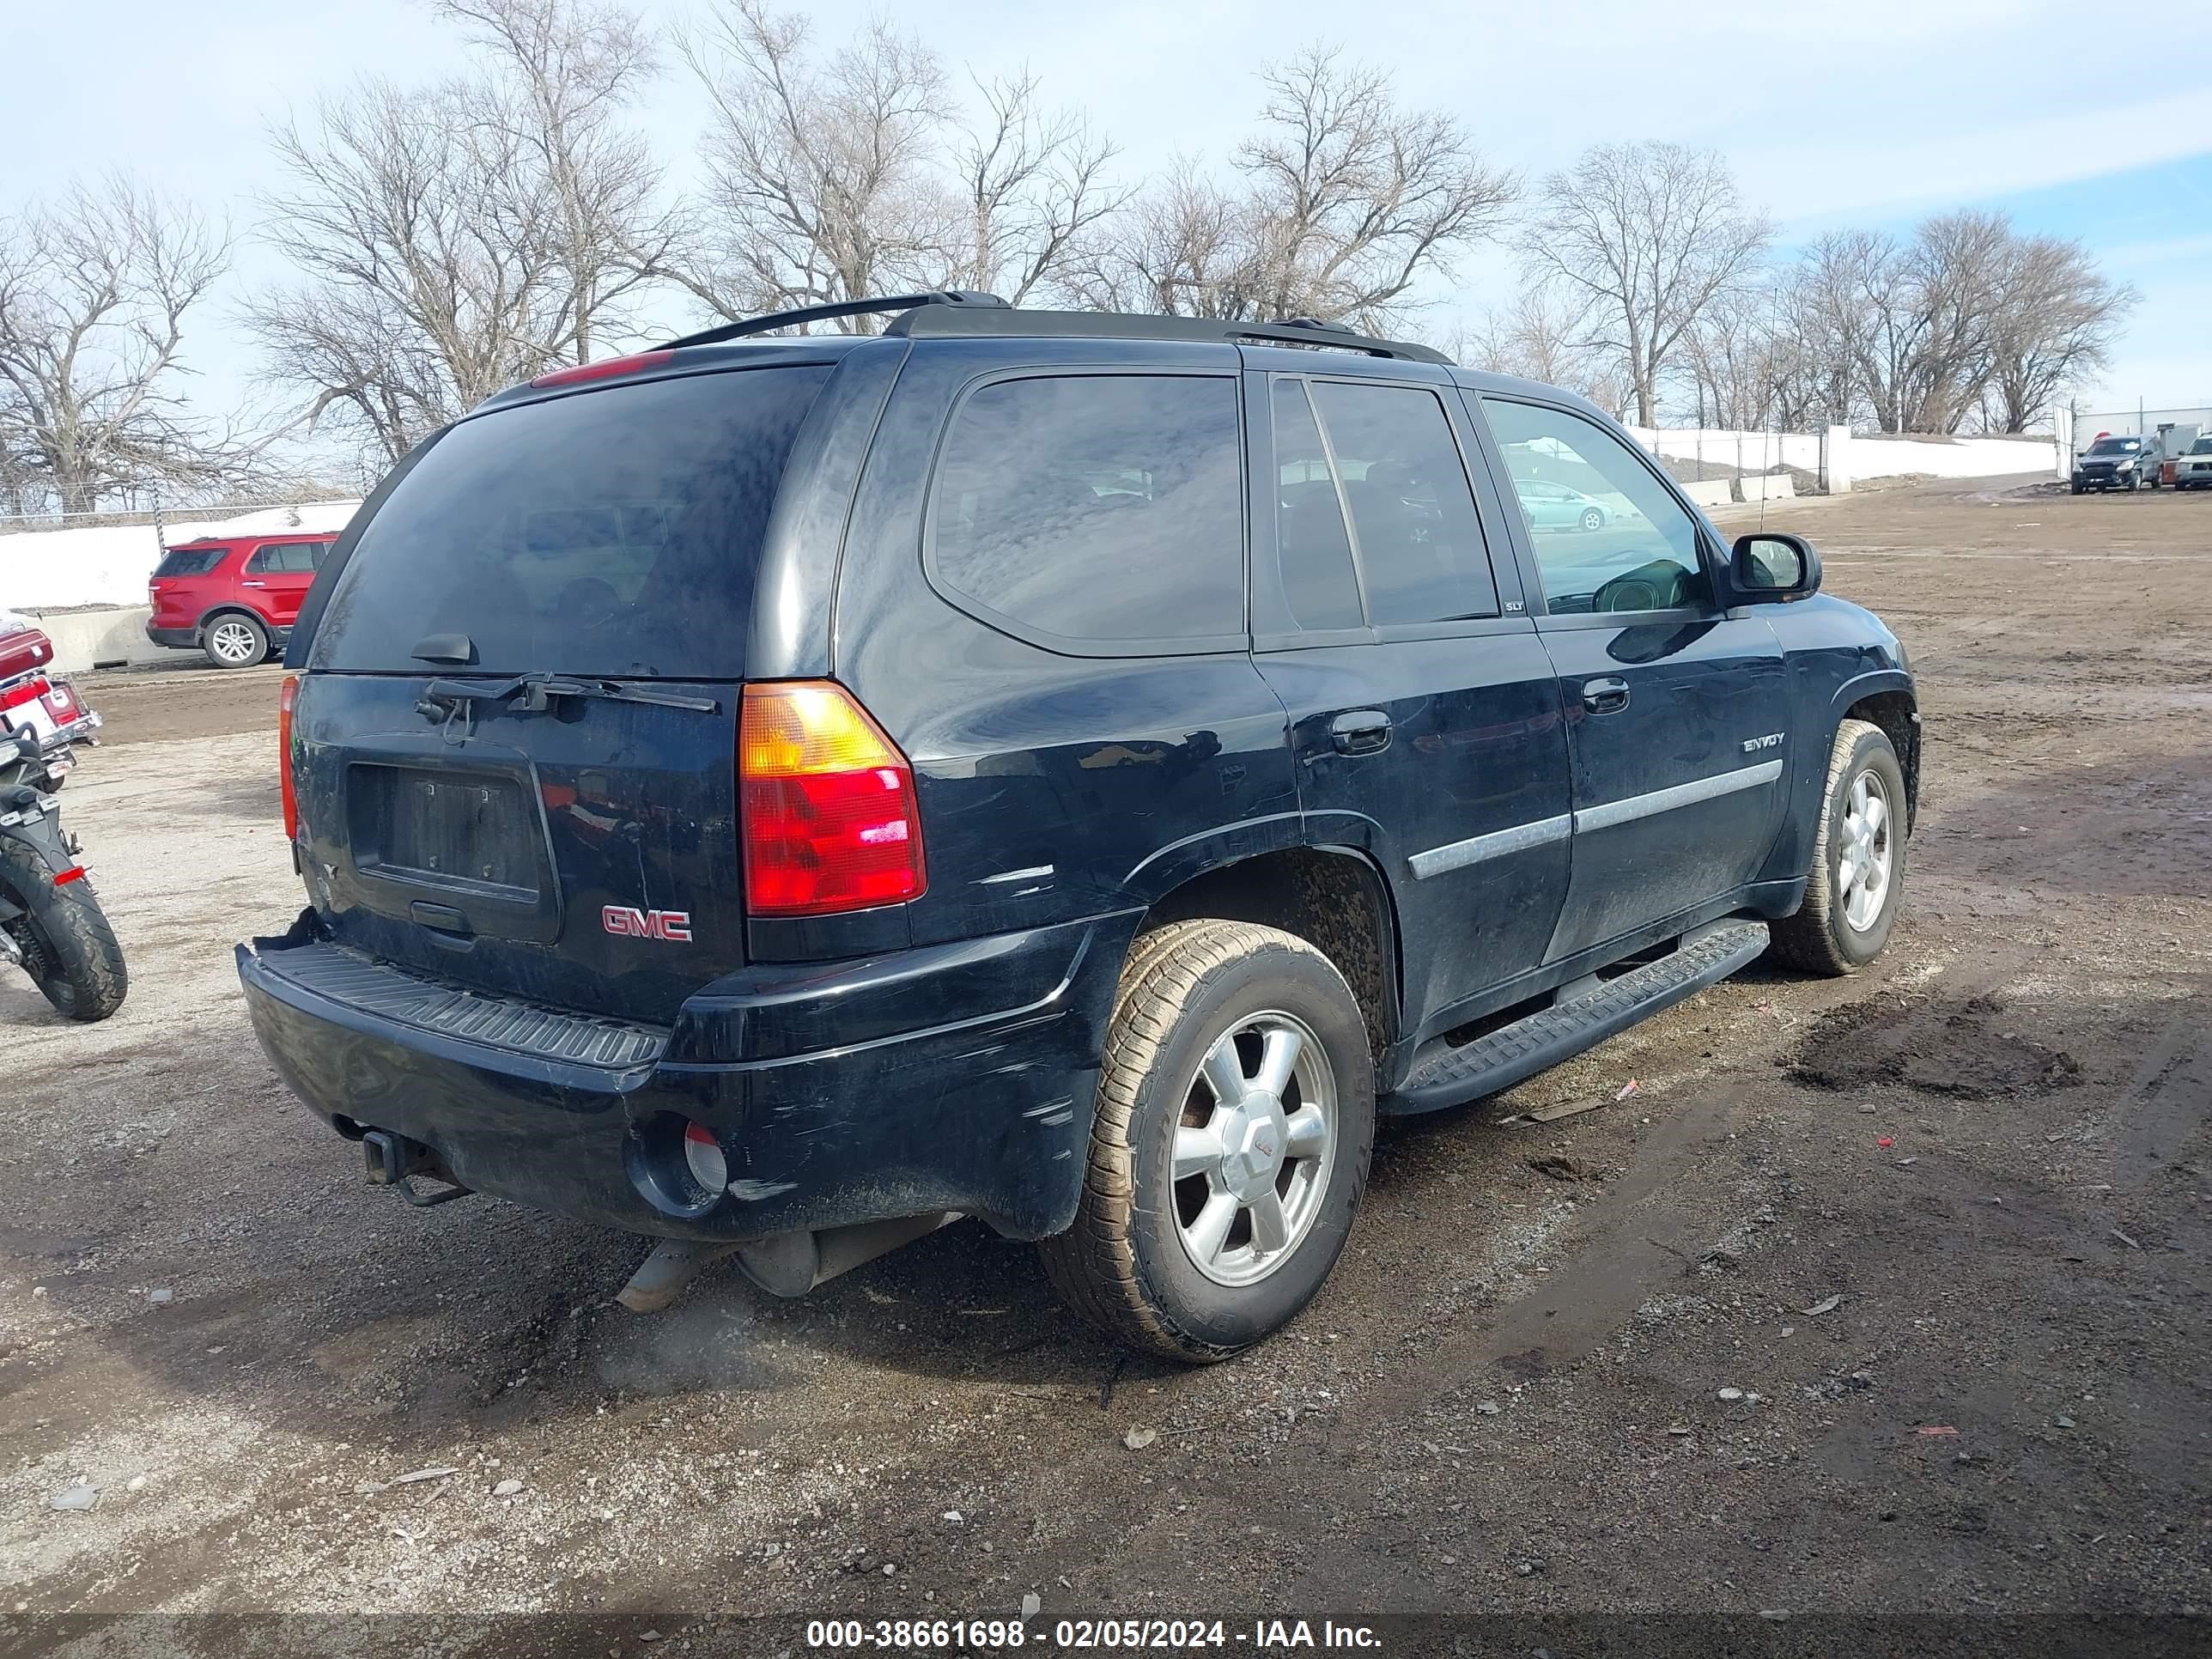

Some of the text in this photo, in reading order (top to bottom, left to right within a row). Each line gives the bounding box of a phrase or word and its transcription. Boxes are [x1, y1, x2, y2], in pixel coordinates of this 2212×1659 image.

[1505, 603, 1522, 611] SLT
[1743, 732, 1785, 752] ENVOY
[602, 904, 693, 942] GMC
